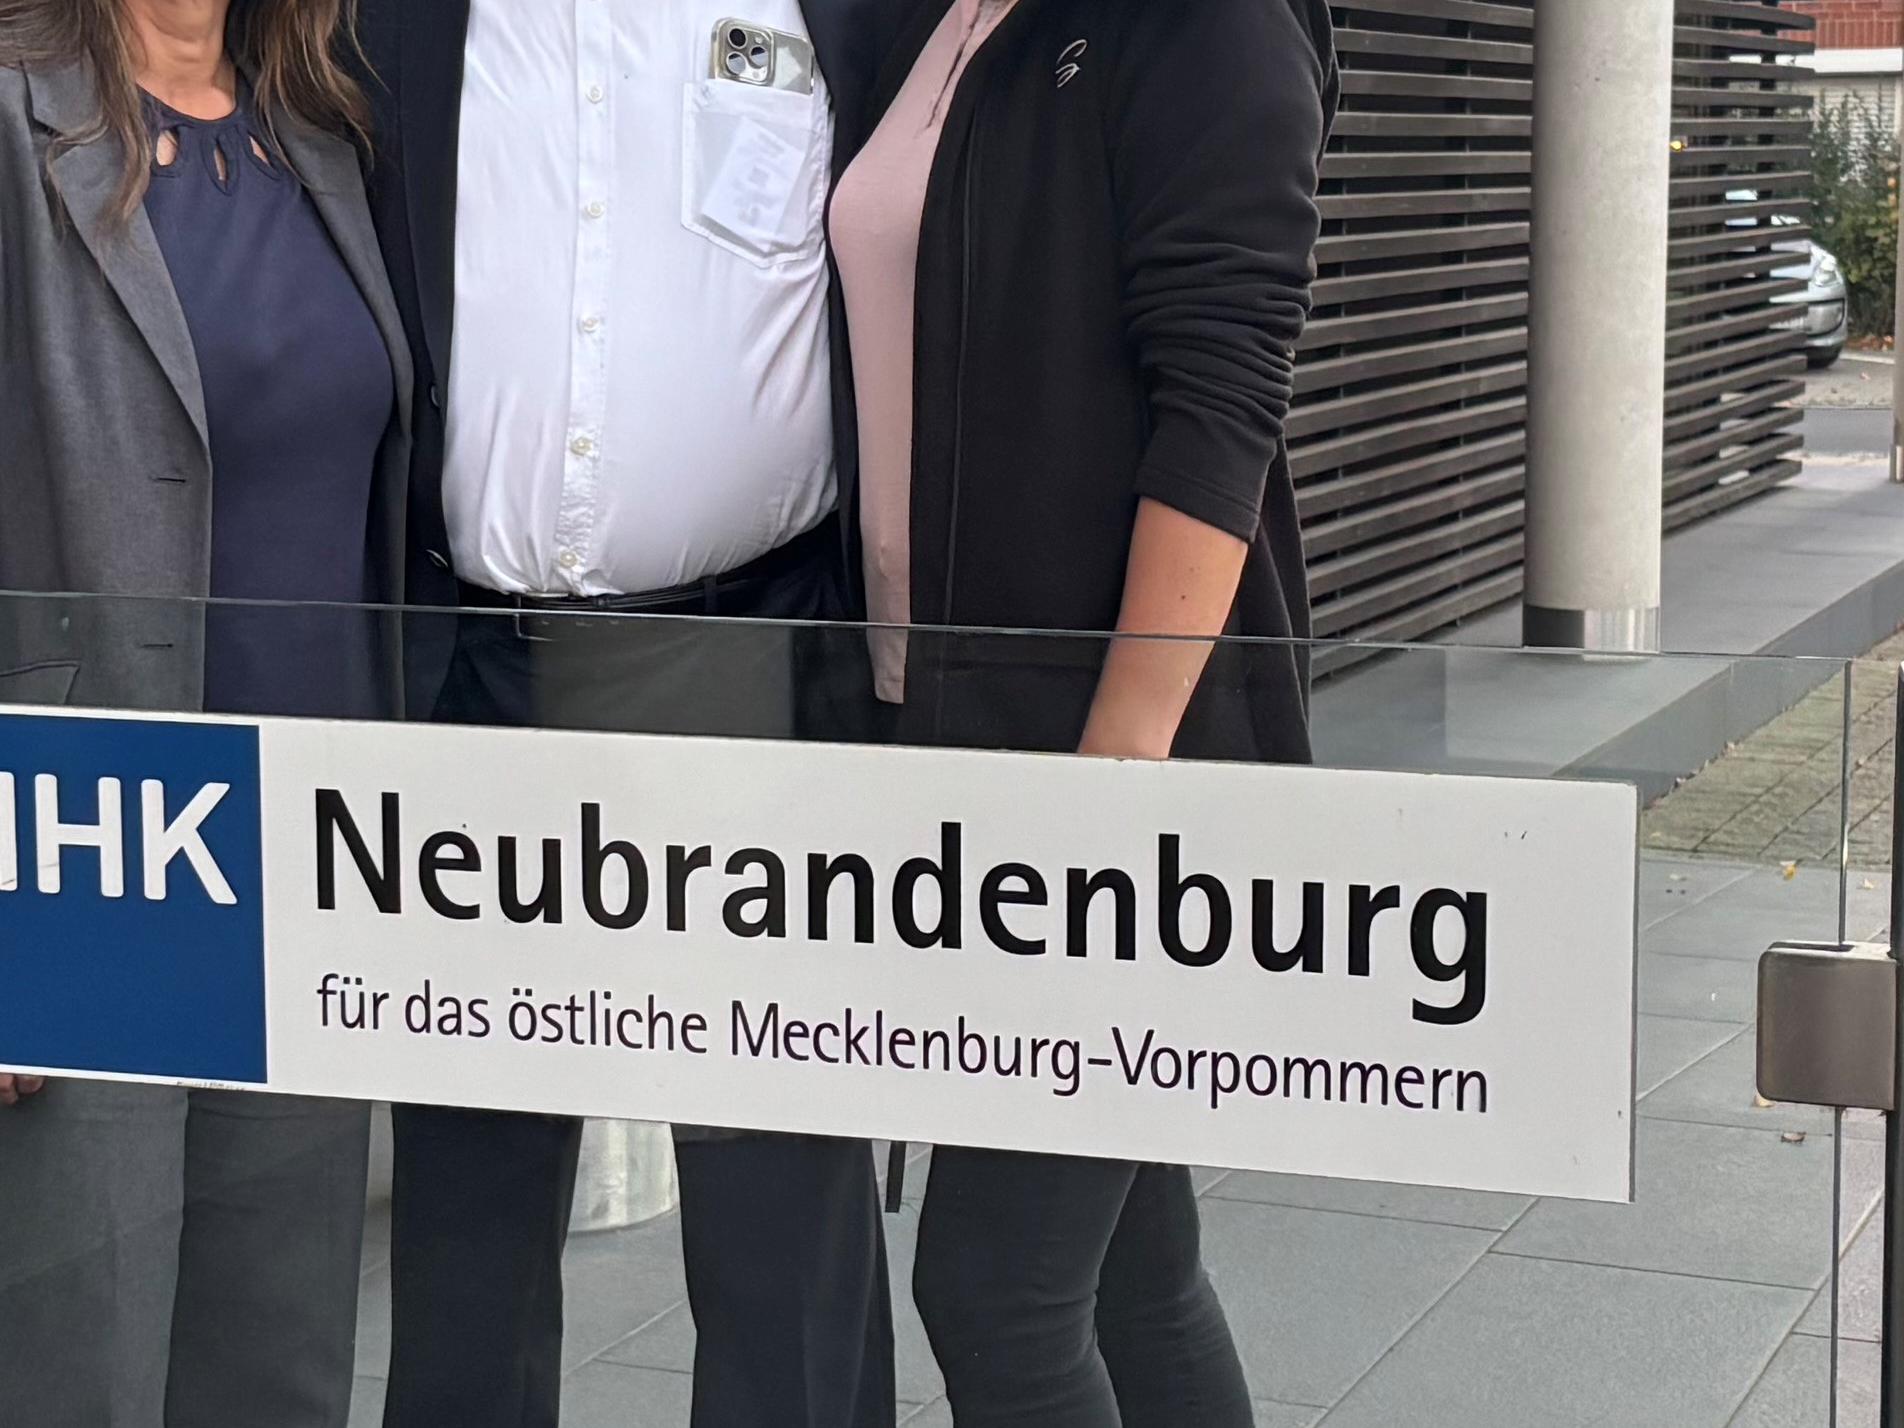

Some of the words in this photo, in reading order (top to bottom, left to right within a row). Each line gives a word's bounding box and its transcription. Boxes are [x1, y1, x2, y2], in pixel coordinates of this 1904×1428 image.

[315, 788, 1488, 1026] Neubrandenburg
[316, 973, 391, 1030] für
[405, 979, 490, 1038] das
[508, 987, 707, 1054] östliche
[731, 1000, 1487, 1113] Mecklenburg-Vorpommern
